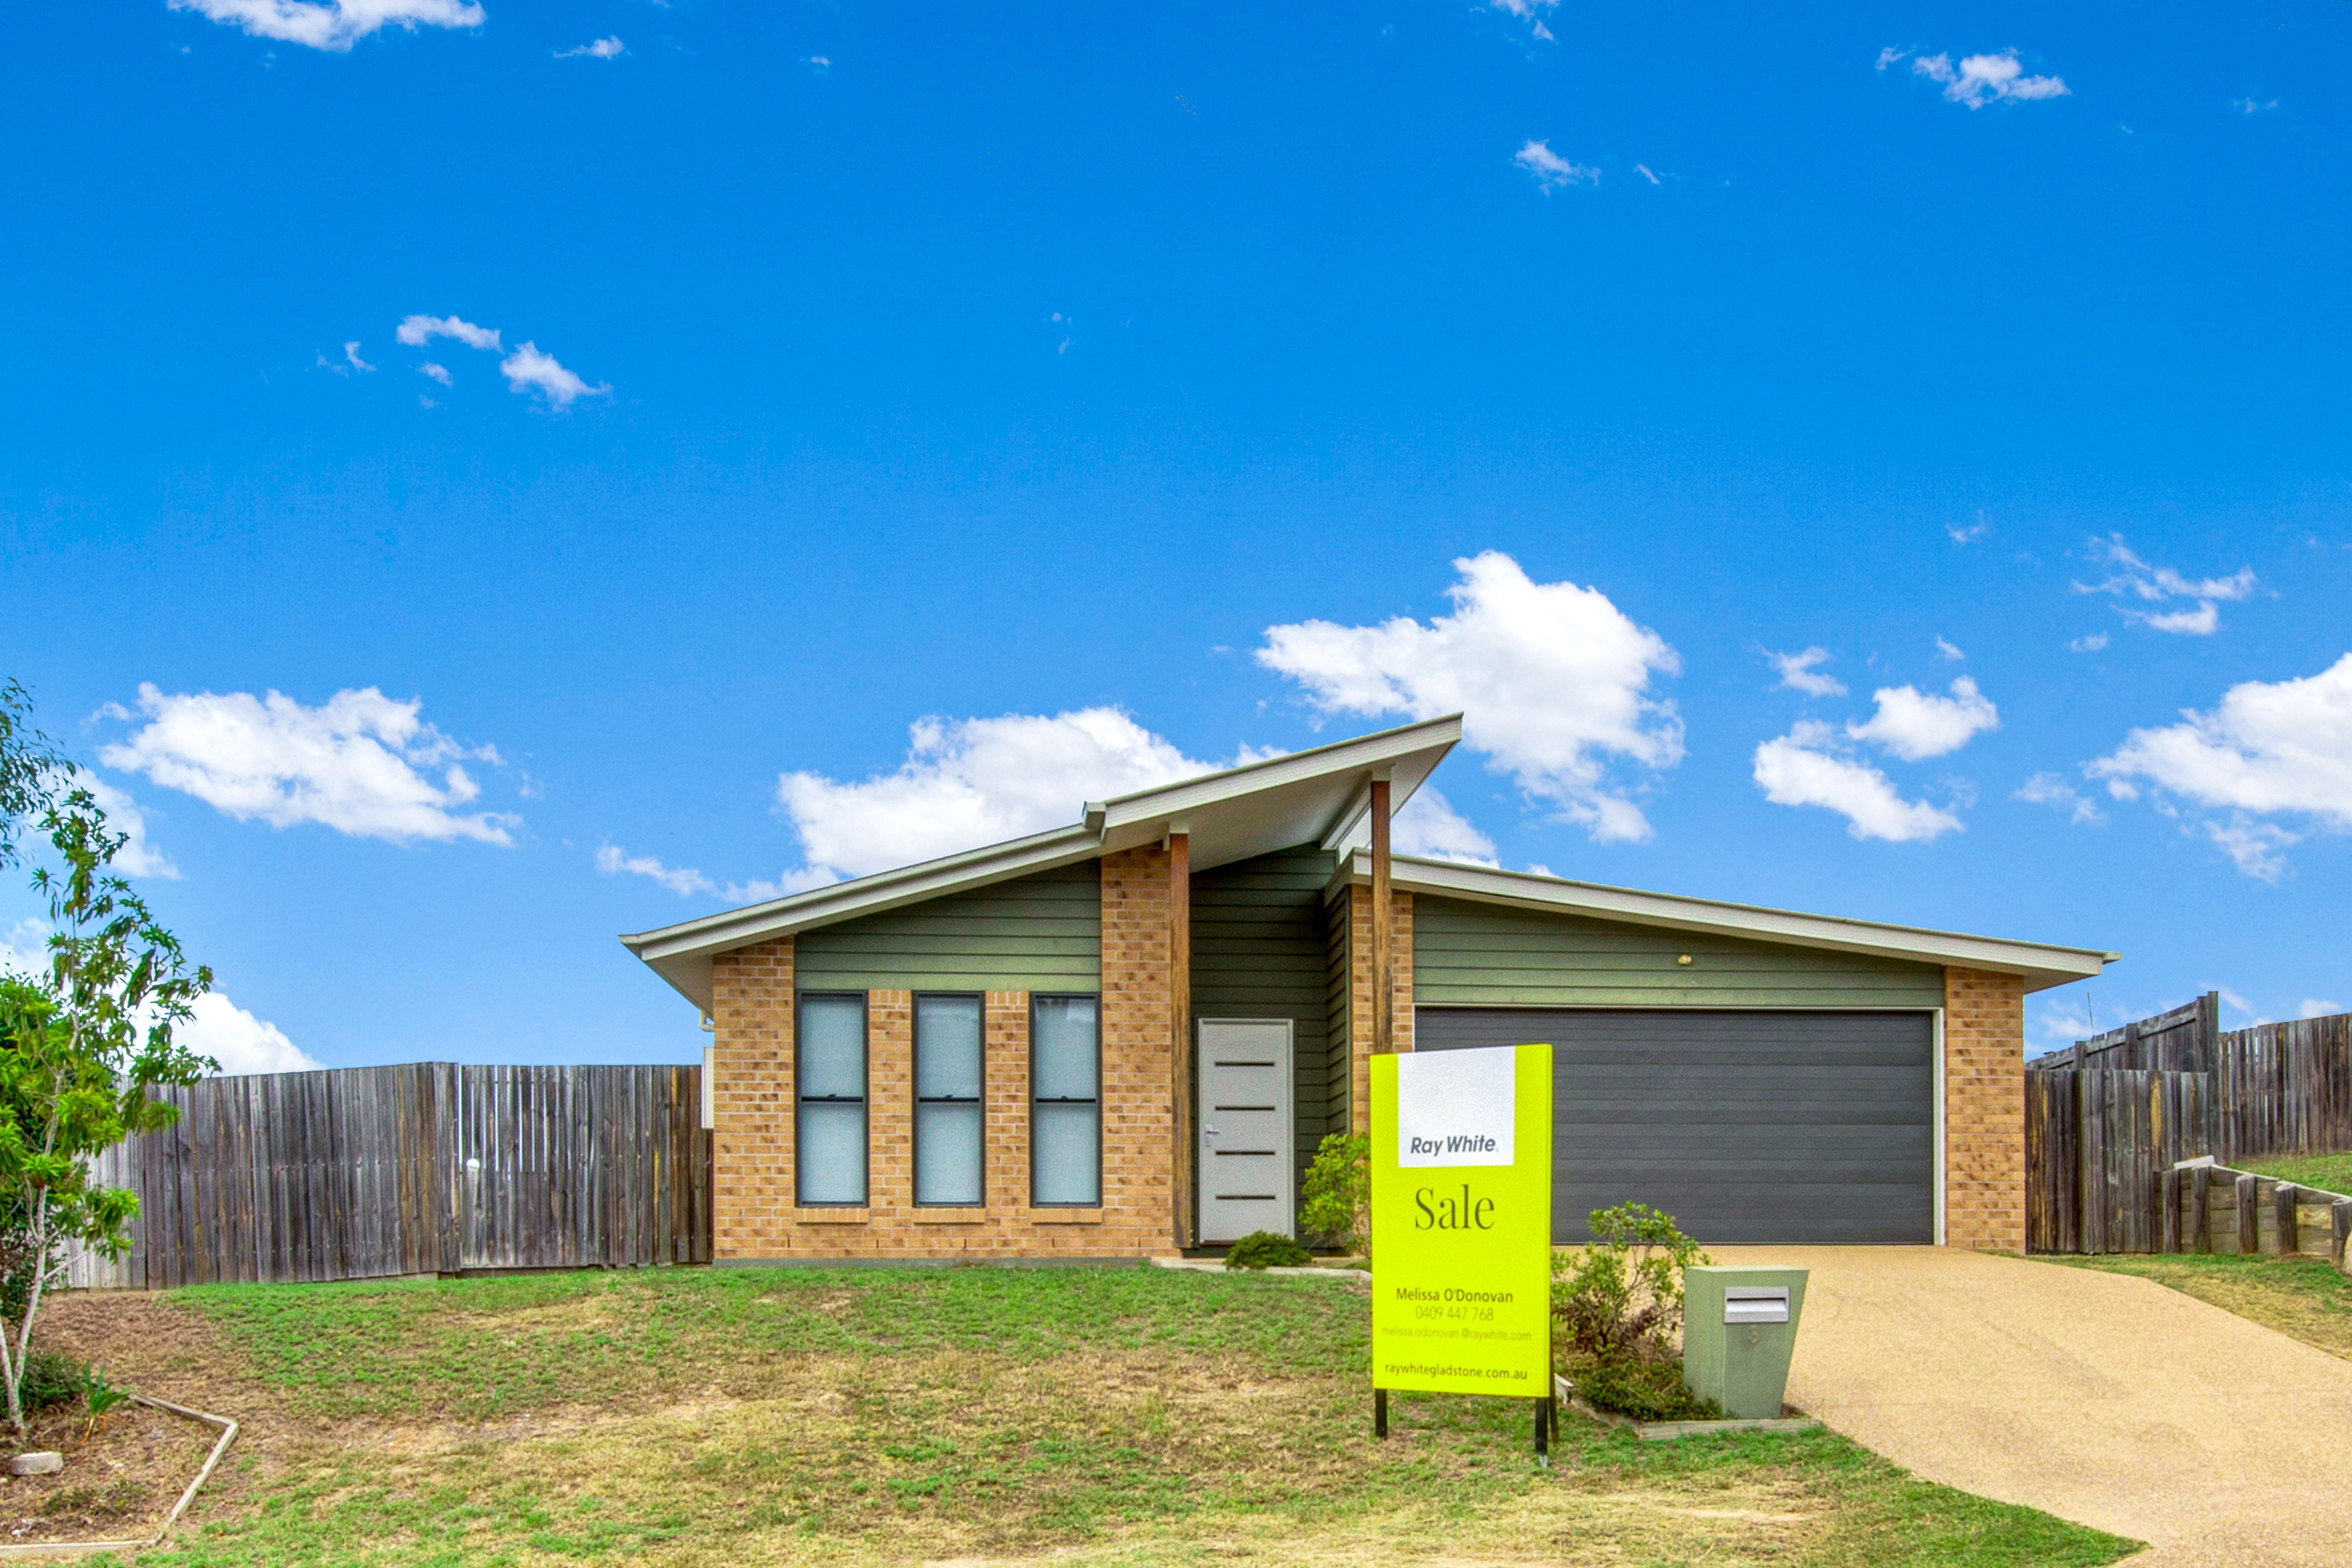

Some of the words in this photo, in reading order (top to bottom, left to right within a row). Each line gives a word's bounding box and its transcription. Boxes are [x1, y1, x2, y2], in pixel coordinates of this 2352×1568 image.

[1411, 1137, 1443, 1156] Ray
[1447, 1135, 1496, 1153] White
[1415, 1183, 1495, 1230] Sale
[1396, 1288, 1440, 1301] Melissa
[1444, 1288, 1513, 1302] O'Donovan
[1416, 1306, 1443, 1320] 0409
[1447, 1307, 1468, 1320] 447
[1473, 1308, 1494, 1321] 768
[1385, 1363, 1527, 1380] raywhitegladstone.com.au
